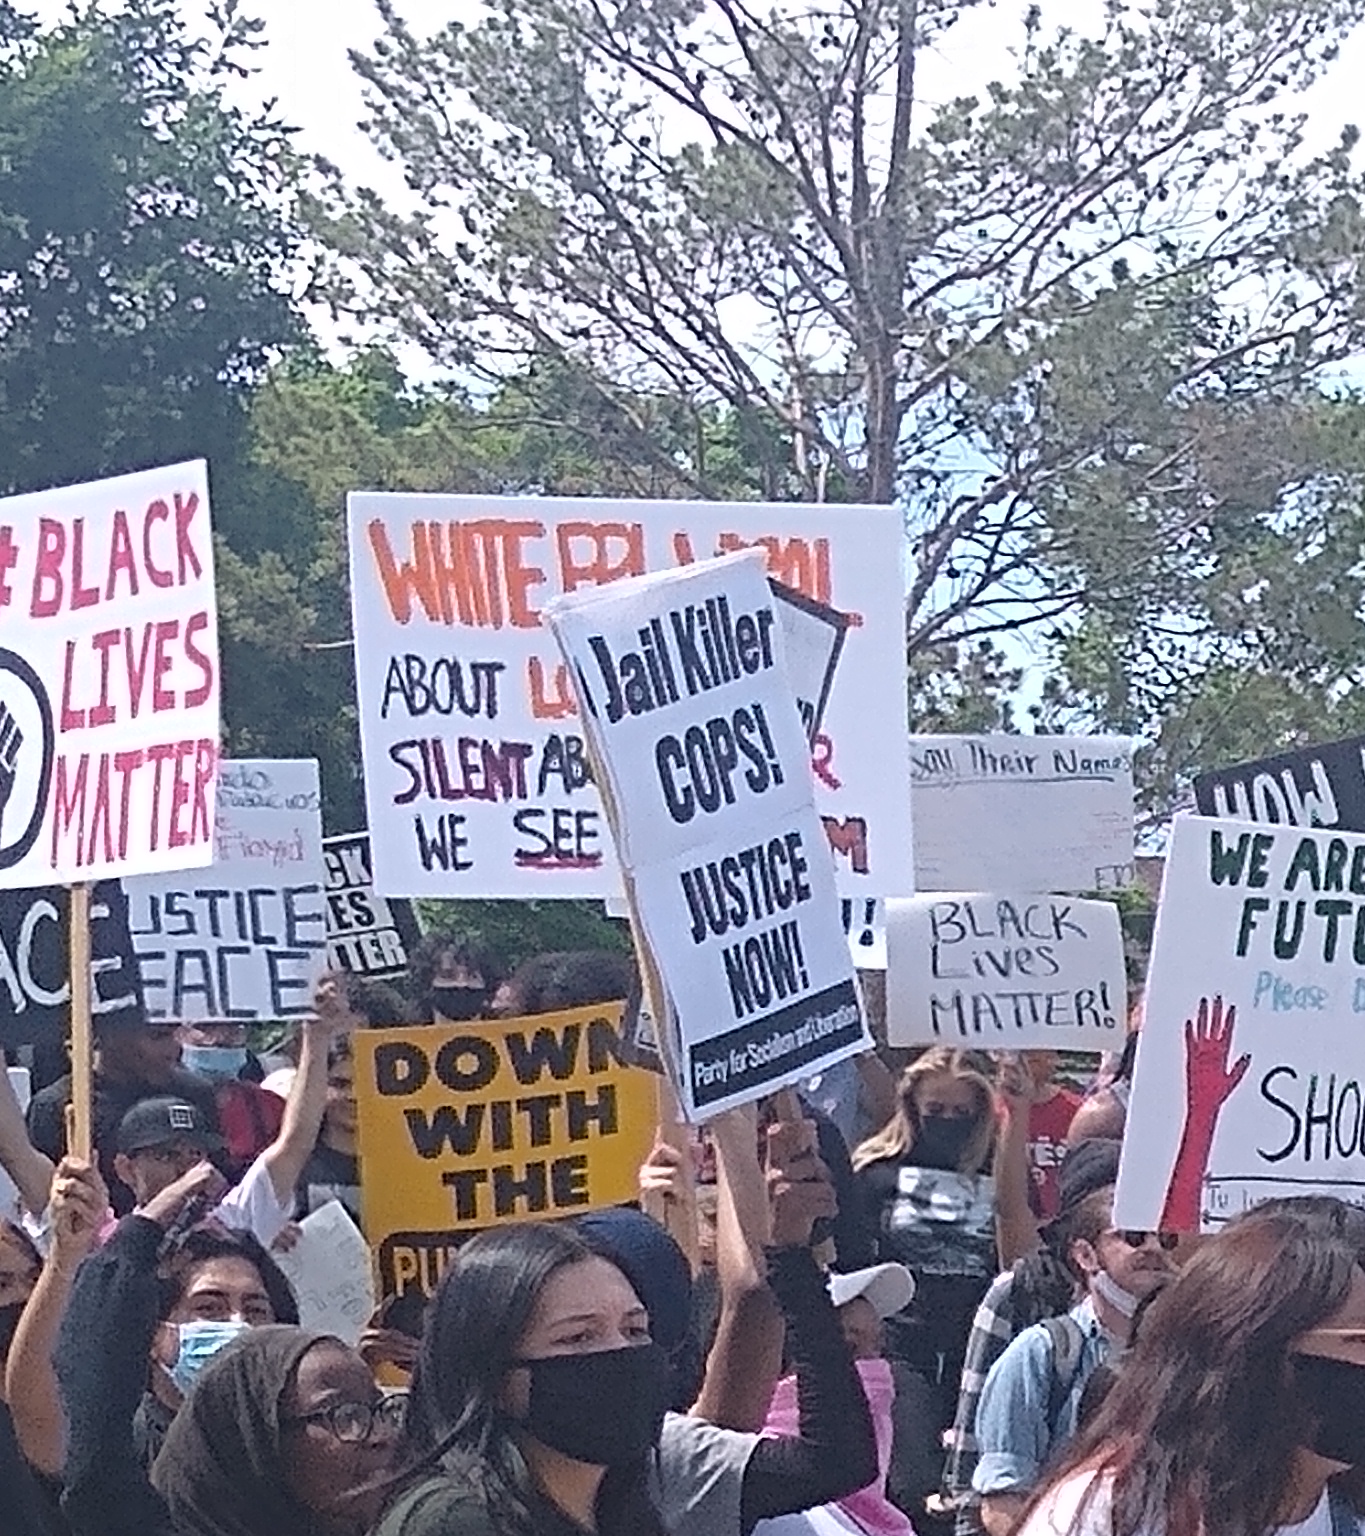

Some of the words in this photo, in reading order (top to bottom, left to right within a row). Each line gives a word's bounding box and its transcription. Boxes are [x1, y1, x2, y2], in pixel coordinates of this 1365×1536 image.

[368, 518, 547, 631] WHITE
[60, 611, 214, 733] LIVES
[381, 654, 506, 719] ABOUT
[587, 618, 680, 724] Jail
[670, 594, 776, 696] Killer
[389, 737, 532, 804] SILENT
[655, 702, 785, 824] COPS!
[1214, 760, 1339, 827] HOW
[51, 738, 215, 868] MATTER
[414, 814, 473, 871] WE
[513, 808, 599, 860] SEE
[1210, 831, 1274, 887] WE
[680, 829, 812, 945] JUSTICE
[931, 900, 1087, 945] BLACK
[722, 919, 811, 1019] NOW!
[1254, 970, 1328, 1012] Please
[930, 981, 1117, 1036] MATTER!
[374, 1017, 628, 1097] DOWN
[404, 1084, 619, 1160] WITH
[442, 1154, 590, 1222] THE
